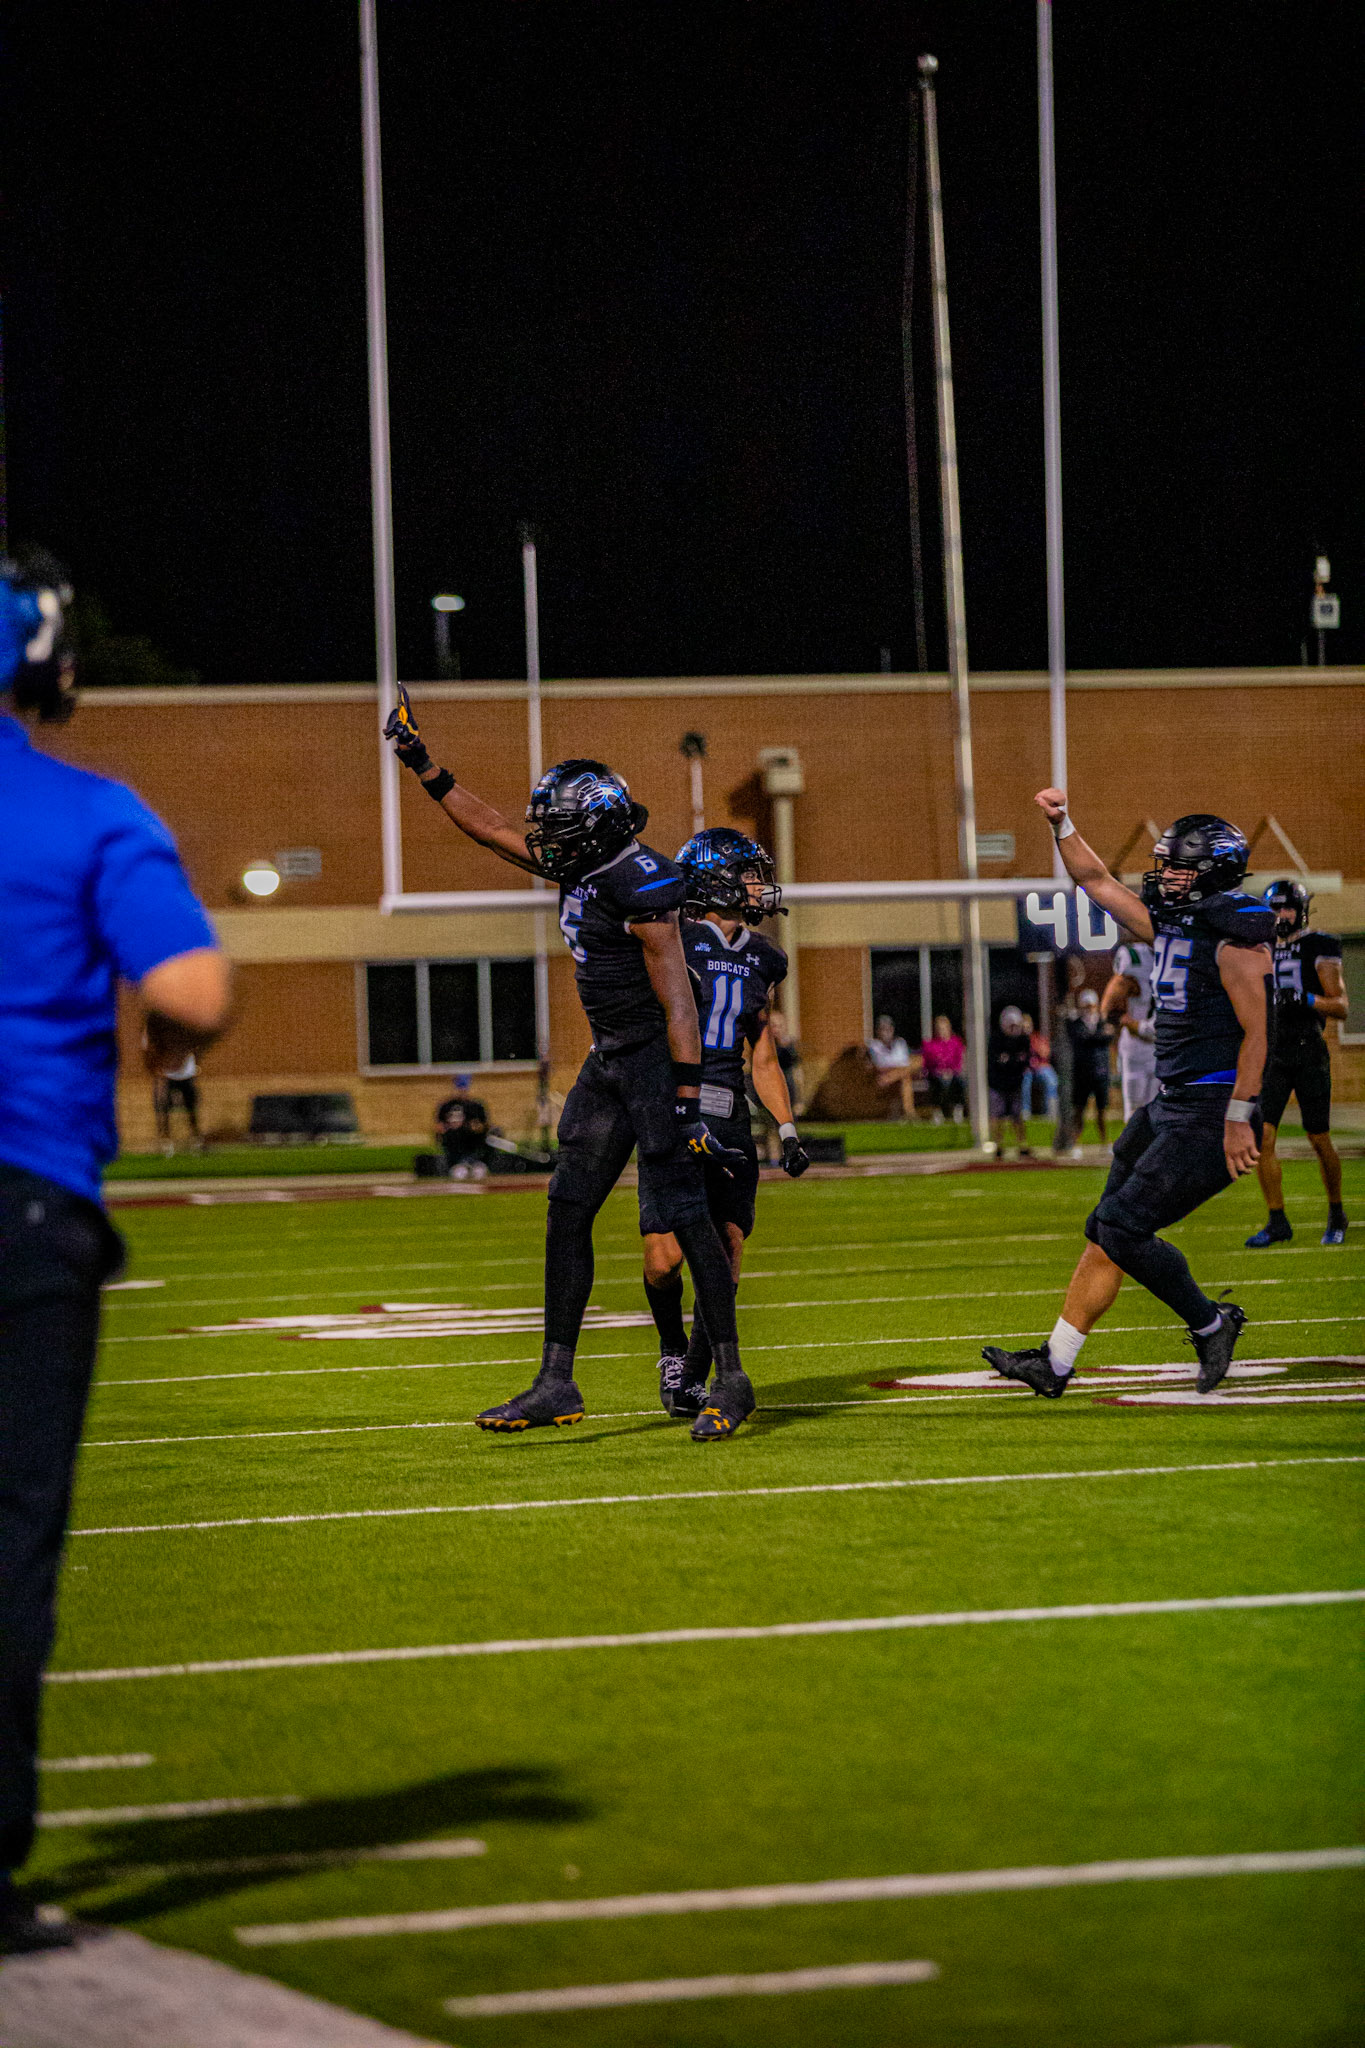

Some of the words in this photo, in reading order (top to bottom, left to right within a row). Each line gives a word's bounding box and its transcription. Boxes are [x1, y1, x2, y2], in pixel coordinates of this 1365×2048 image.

[633, 855, 659, 875] 6
[1026, 885, 1118, 951] 40
[707, 959, 751, 977] BOBCATS
[704, 973, 744, 1049] 11
